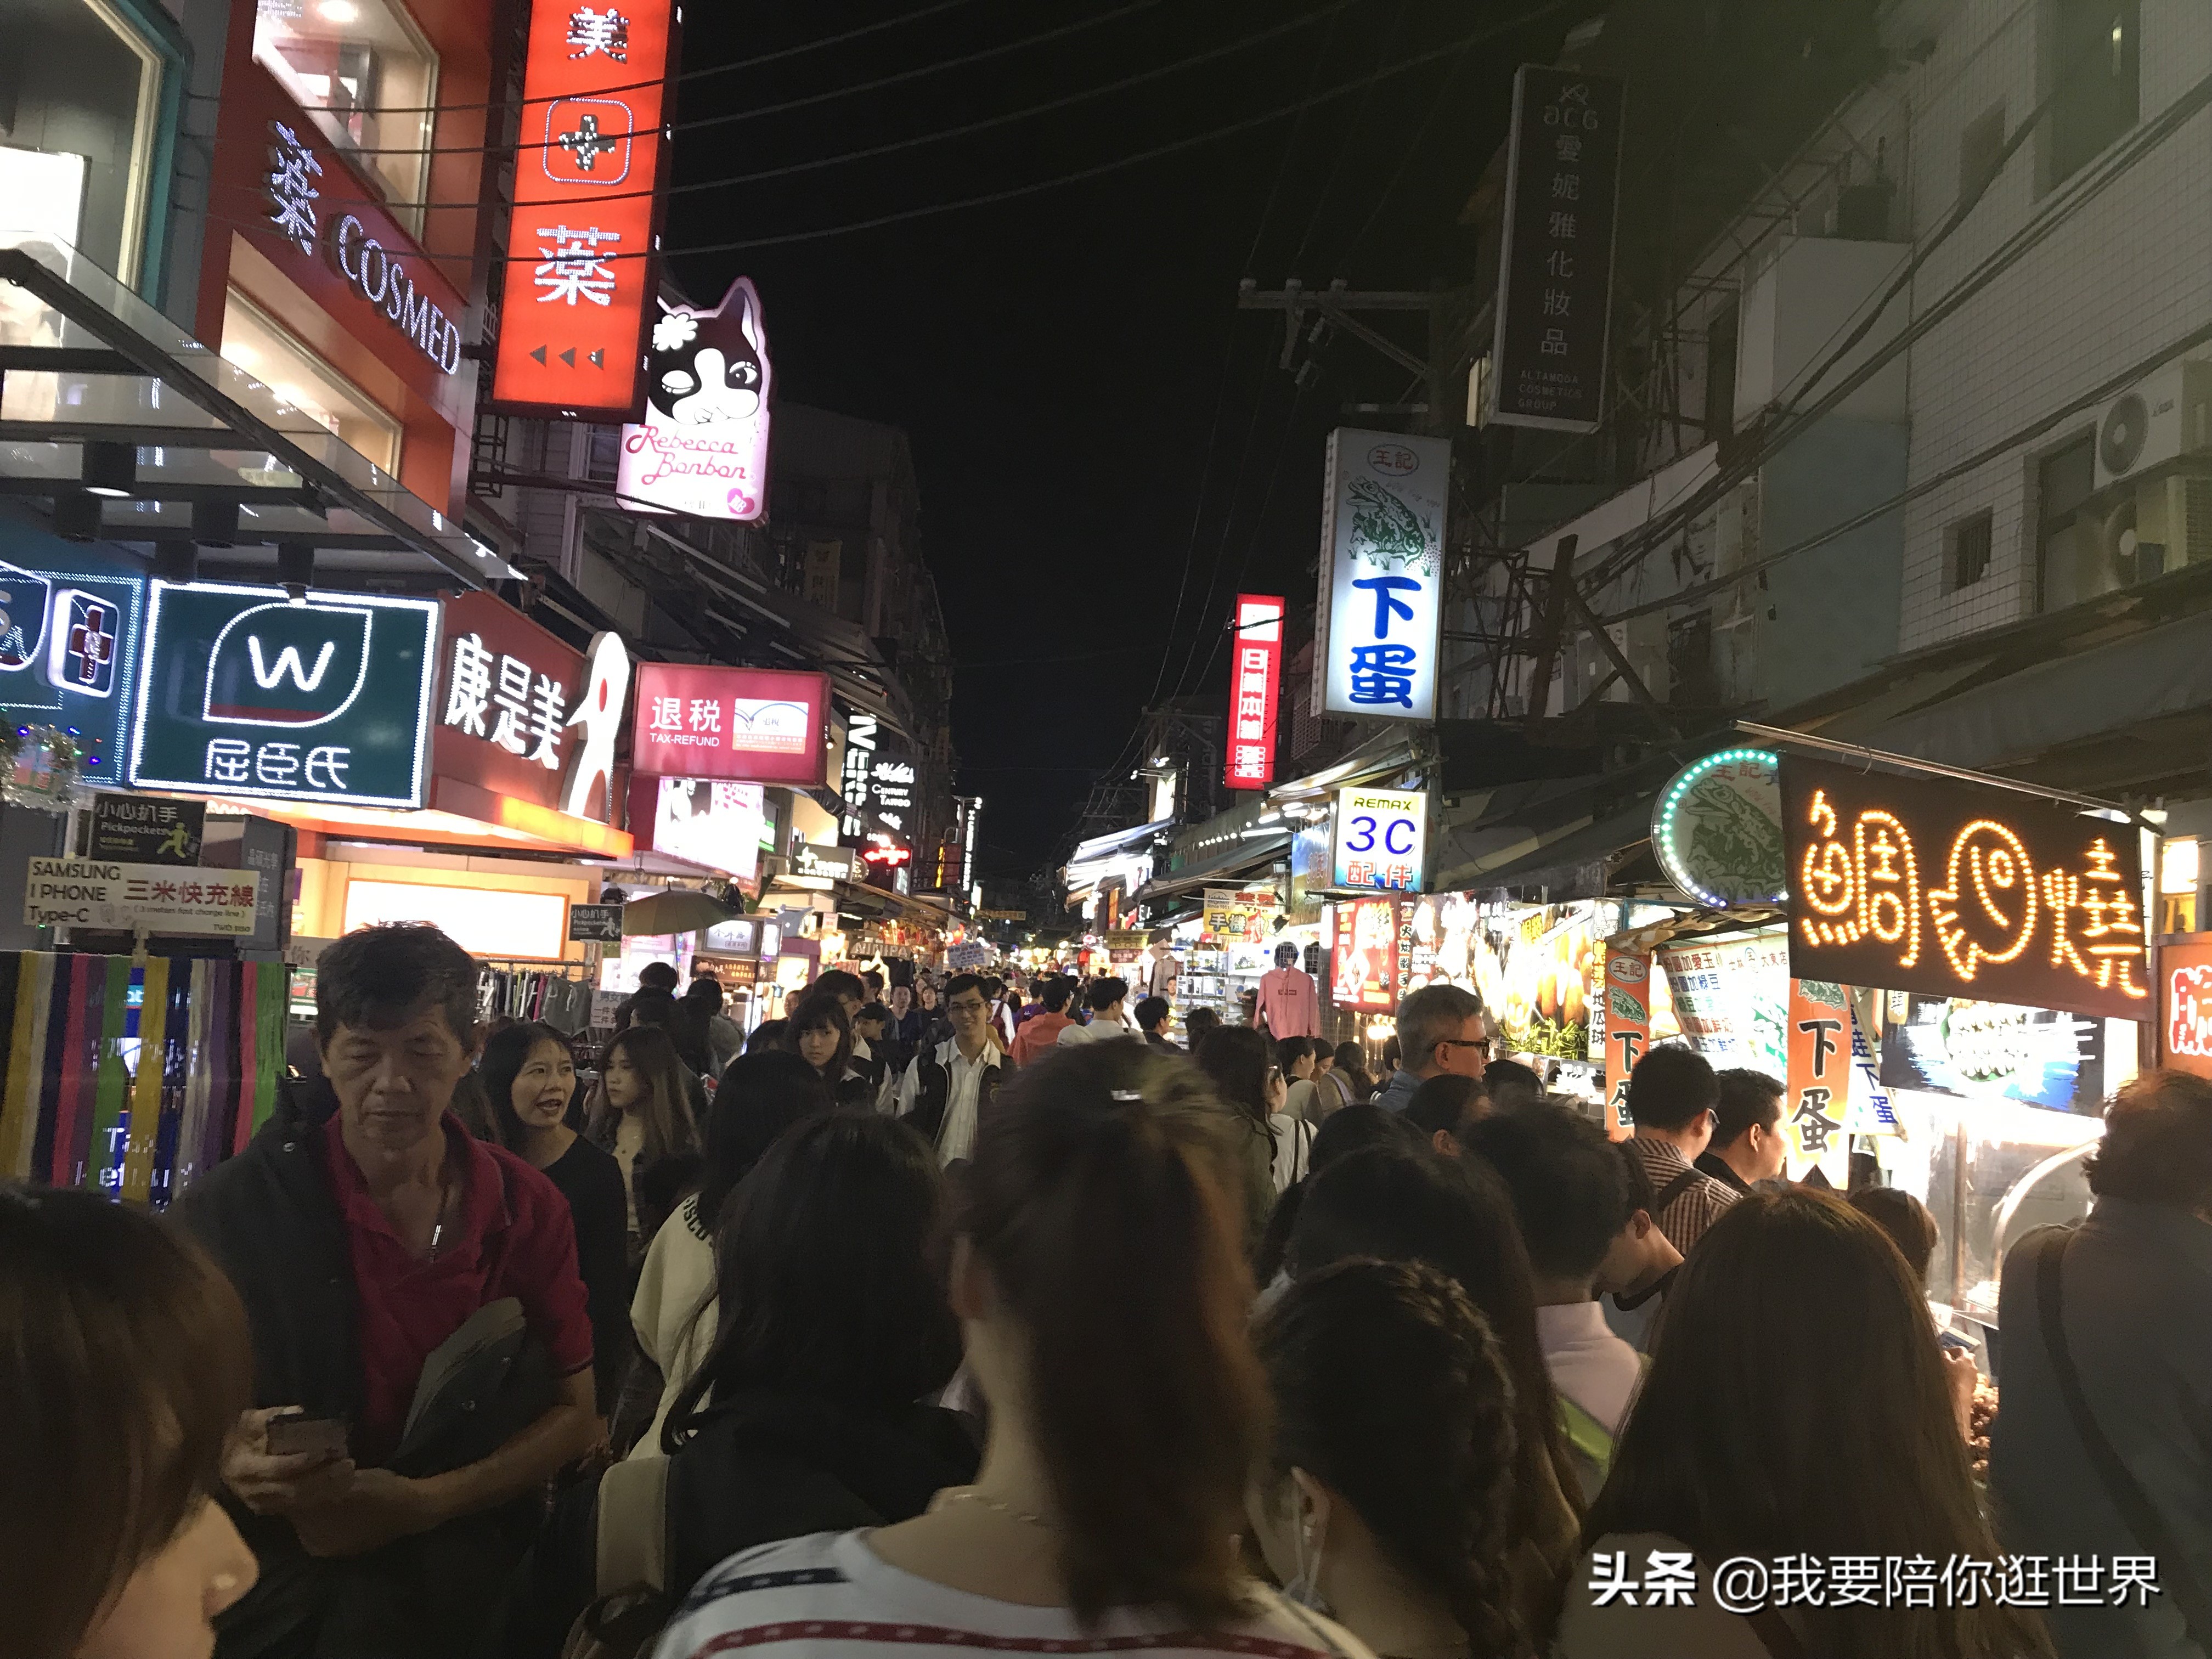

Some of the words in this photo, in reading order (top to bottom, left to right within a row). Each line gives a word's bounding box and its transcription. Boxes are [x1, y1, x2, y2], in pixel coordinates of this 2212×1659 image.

[567, 6, 629, 63] 美
[338, 215, 460, 375] COSMED
[1518, 398, 1556, 411] GROUP
[625, 425, 738, 454] Rebecca
[641, 452, 746, 485] Bonbon
[1373, 450, 1414, 470] 王記
[1349, 576, 1422, 708] 下蛋
[249, 635, 334, 692] W
[444, 633, 565, 770] 康是美
[650, 732, 720, 747] TAX-REFUND
[205, 738, 351, 789] 屈臣氏
[1353, 797, 1412, 811] REMAX
[32, 861, 121, 881] SAMSUNG
[1347, 860, 1413, 889] 配件
[40, 883, 107, 902] PHONE
[123, 879, 254, 907] 三米快充線
[29, 905, 90, 924] Type-C
[1613, 961, 1644, 978] 王記
[1792, 1020, 1842, 1153] 下蛋
